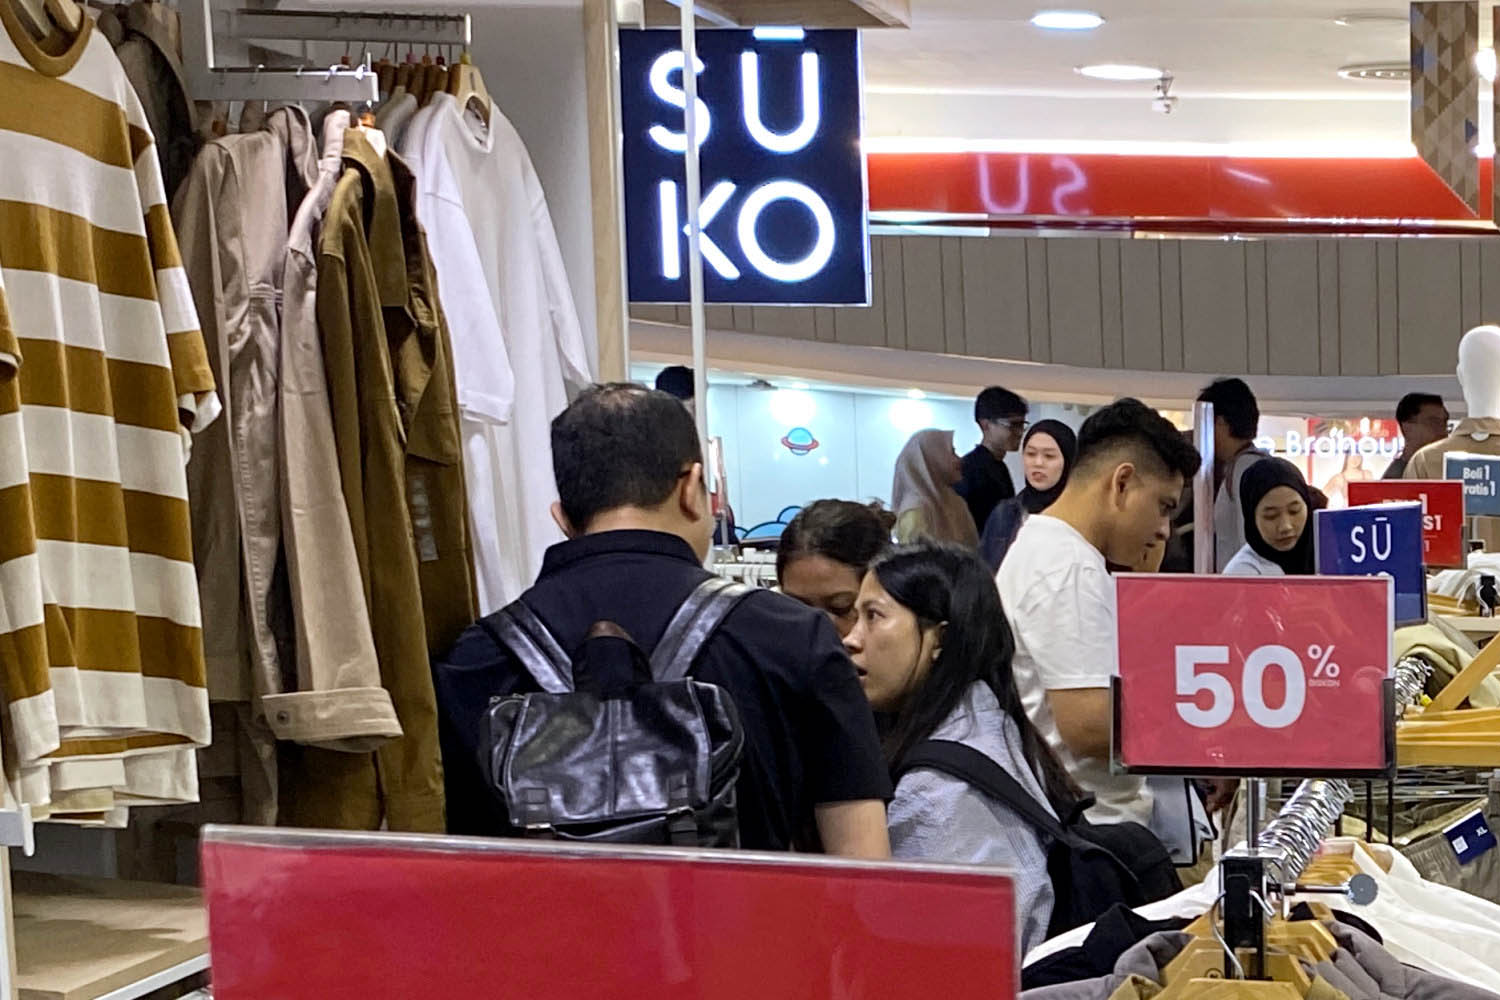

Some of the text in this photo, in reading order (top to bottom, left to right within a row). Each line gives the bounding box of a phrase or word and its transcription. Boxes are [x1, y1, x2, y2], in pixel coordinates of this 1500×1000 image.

[658, 181, 836, 282] KO
[1463, 464, 1490, 481] Beli 1
[1463, 480, 1496, 497] ratis 1
